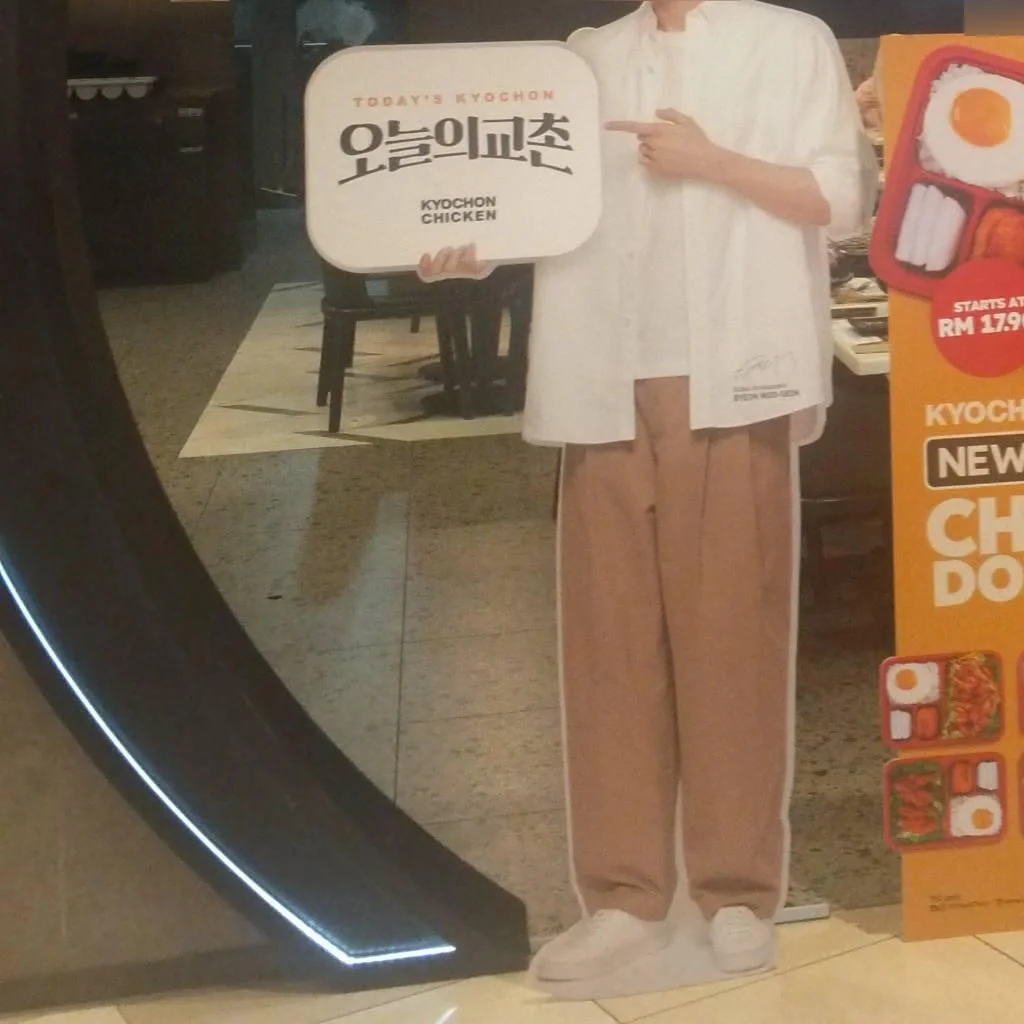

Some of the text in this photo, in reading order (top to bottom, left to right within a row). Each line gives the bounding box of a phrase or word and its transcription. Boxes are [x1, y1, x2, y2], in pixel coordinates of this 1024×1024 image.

[353, 89, 556, 109] TODAY'S KYOCHON
[420, 195, 497, 212] KYOCHON
[421, 209, 497, 225] CHICKEN
[952, 297, 1006, 313] STARTS
[937, 315, 976, 338] RM
